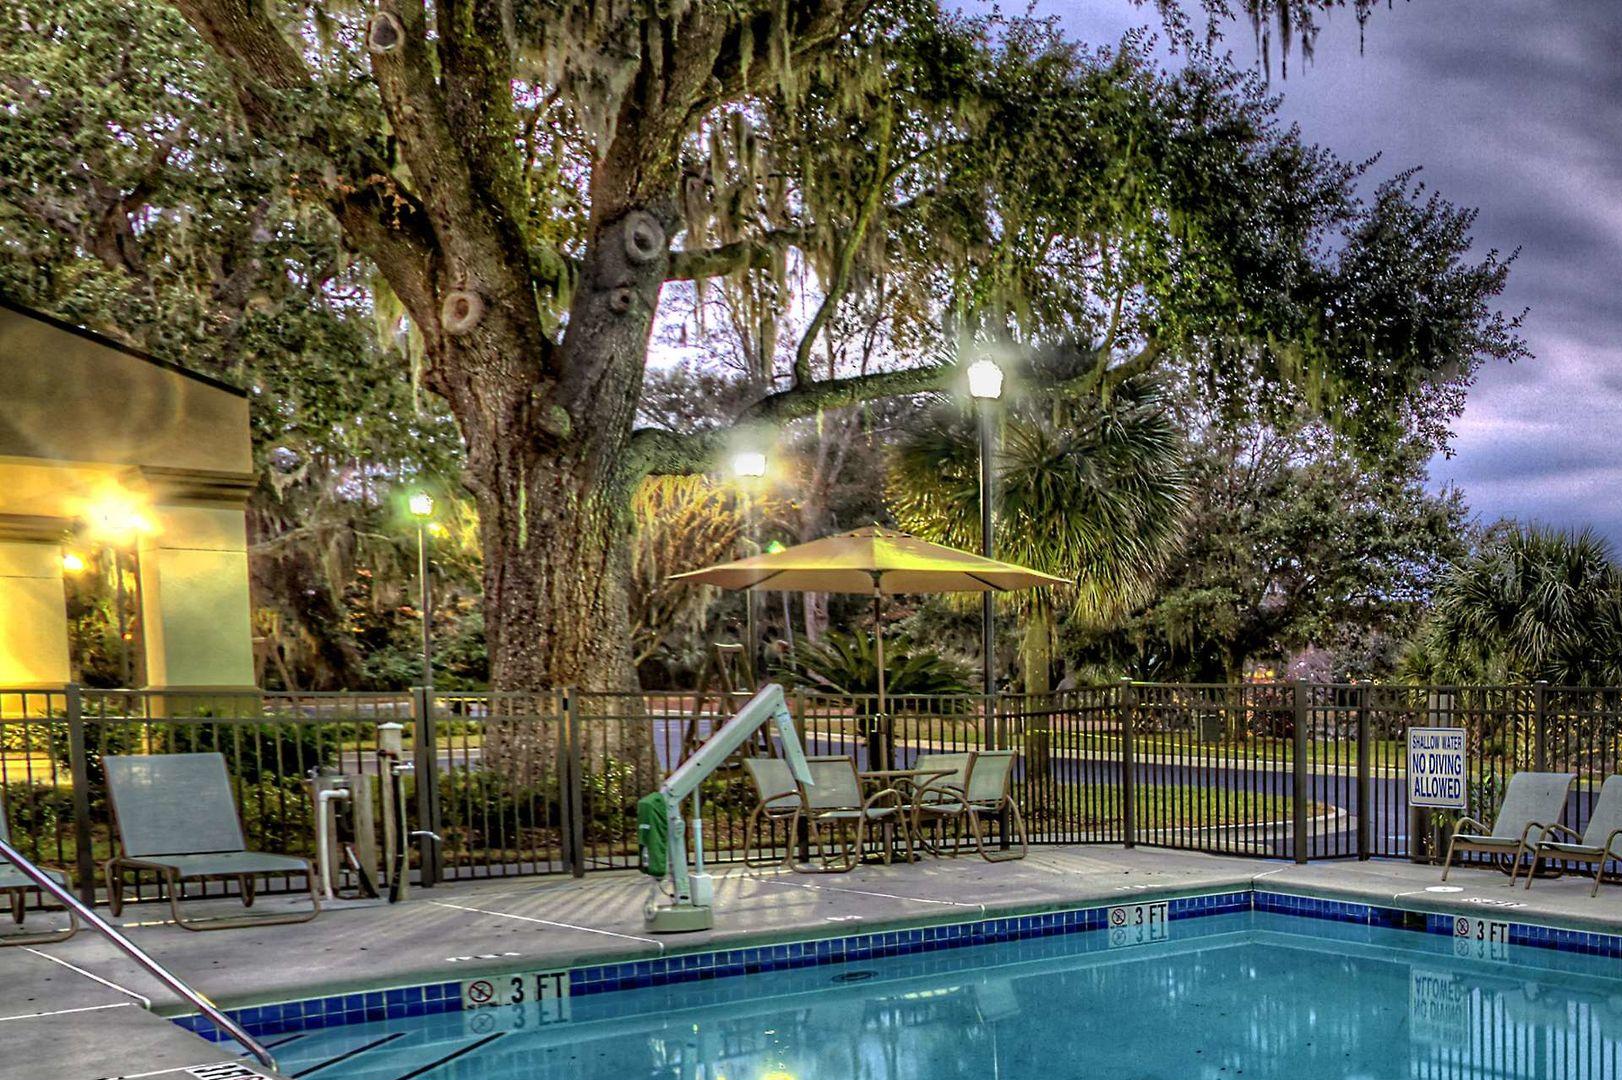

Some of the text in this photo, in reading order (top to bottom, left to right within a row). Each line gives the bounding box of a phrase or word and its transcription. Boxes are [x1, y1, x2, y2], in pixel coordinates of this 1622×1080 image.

[1413, 735, 1462, 750] SHALLOW WATER
[1413, 753, 1461, 775] NO DIVING
[1414, 777, 1461, 799] ALLOWED
[1135, 903, 1166, 925] 3 FT
[1477, 920, 1507, 943] 3 FT
[511, 972, 566, 1003] 3 FT
[202, 1069, 255, 1080] FT
